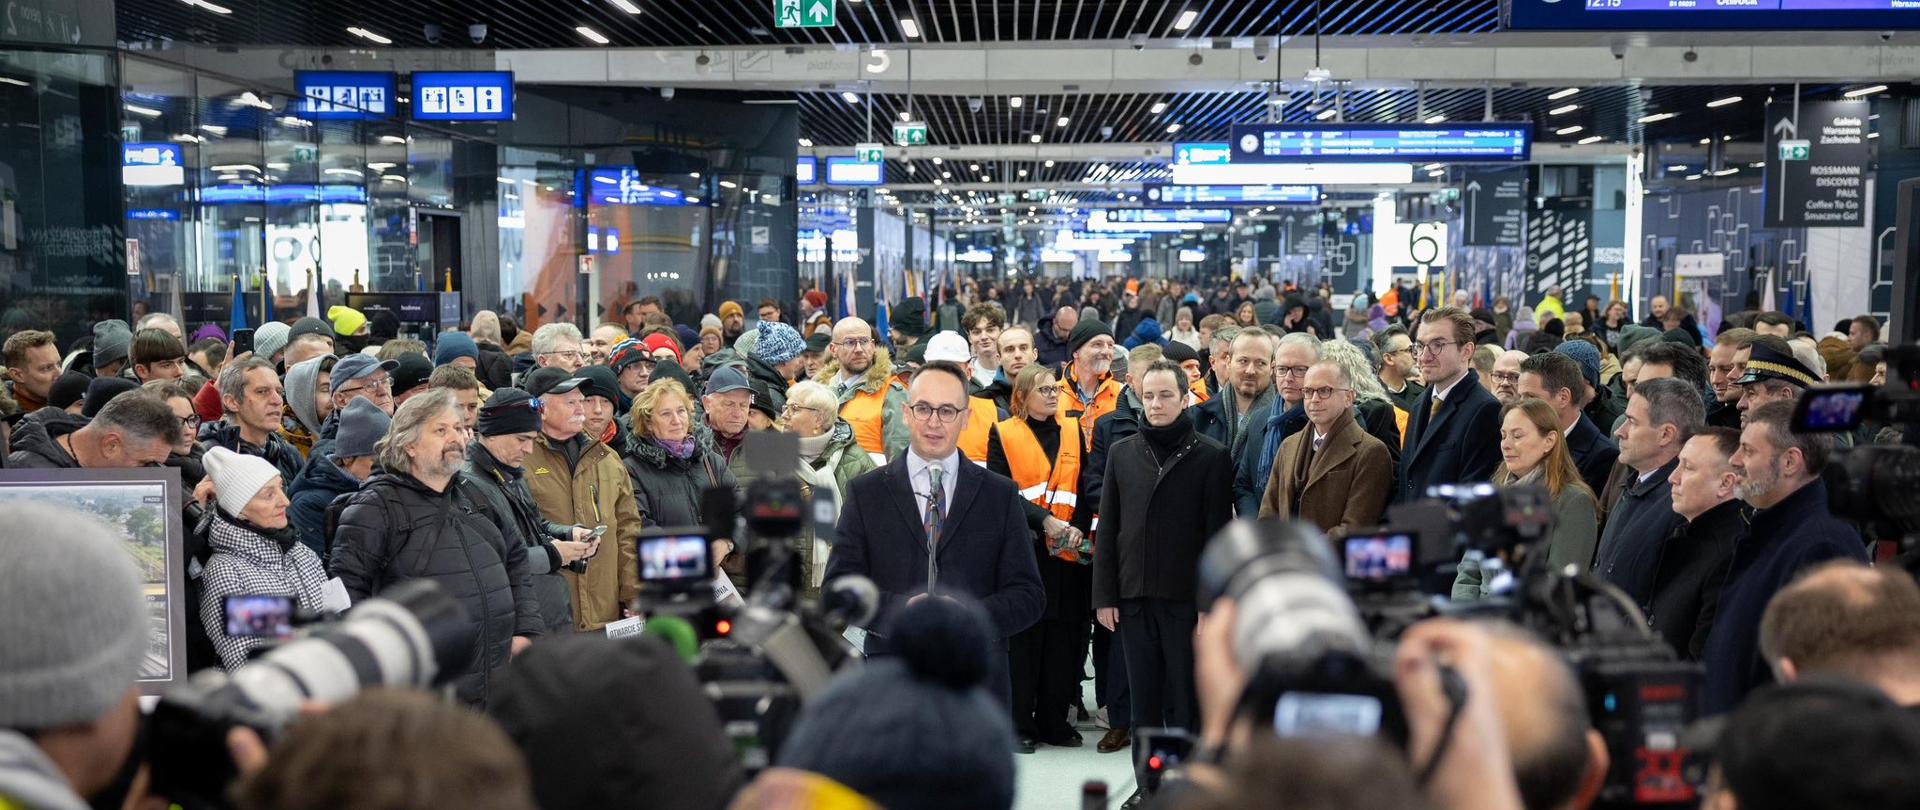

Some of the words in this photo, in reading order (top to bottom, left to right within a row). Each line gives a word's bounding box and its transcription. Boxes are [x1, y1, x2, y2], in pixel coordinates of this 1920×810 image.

[1810, 166, 1860, 175] ROSSMANN
[1816, 177, 1860, 187] DISCOVER
[1836, 189, 1858, 198] PAUL
[1806, 200, 1834, 210] Coffee
[1835, 200, 1845, 210] To
[1845, 200, 1858, 210] Go
[1409, 222, 1439, 265] 6
